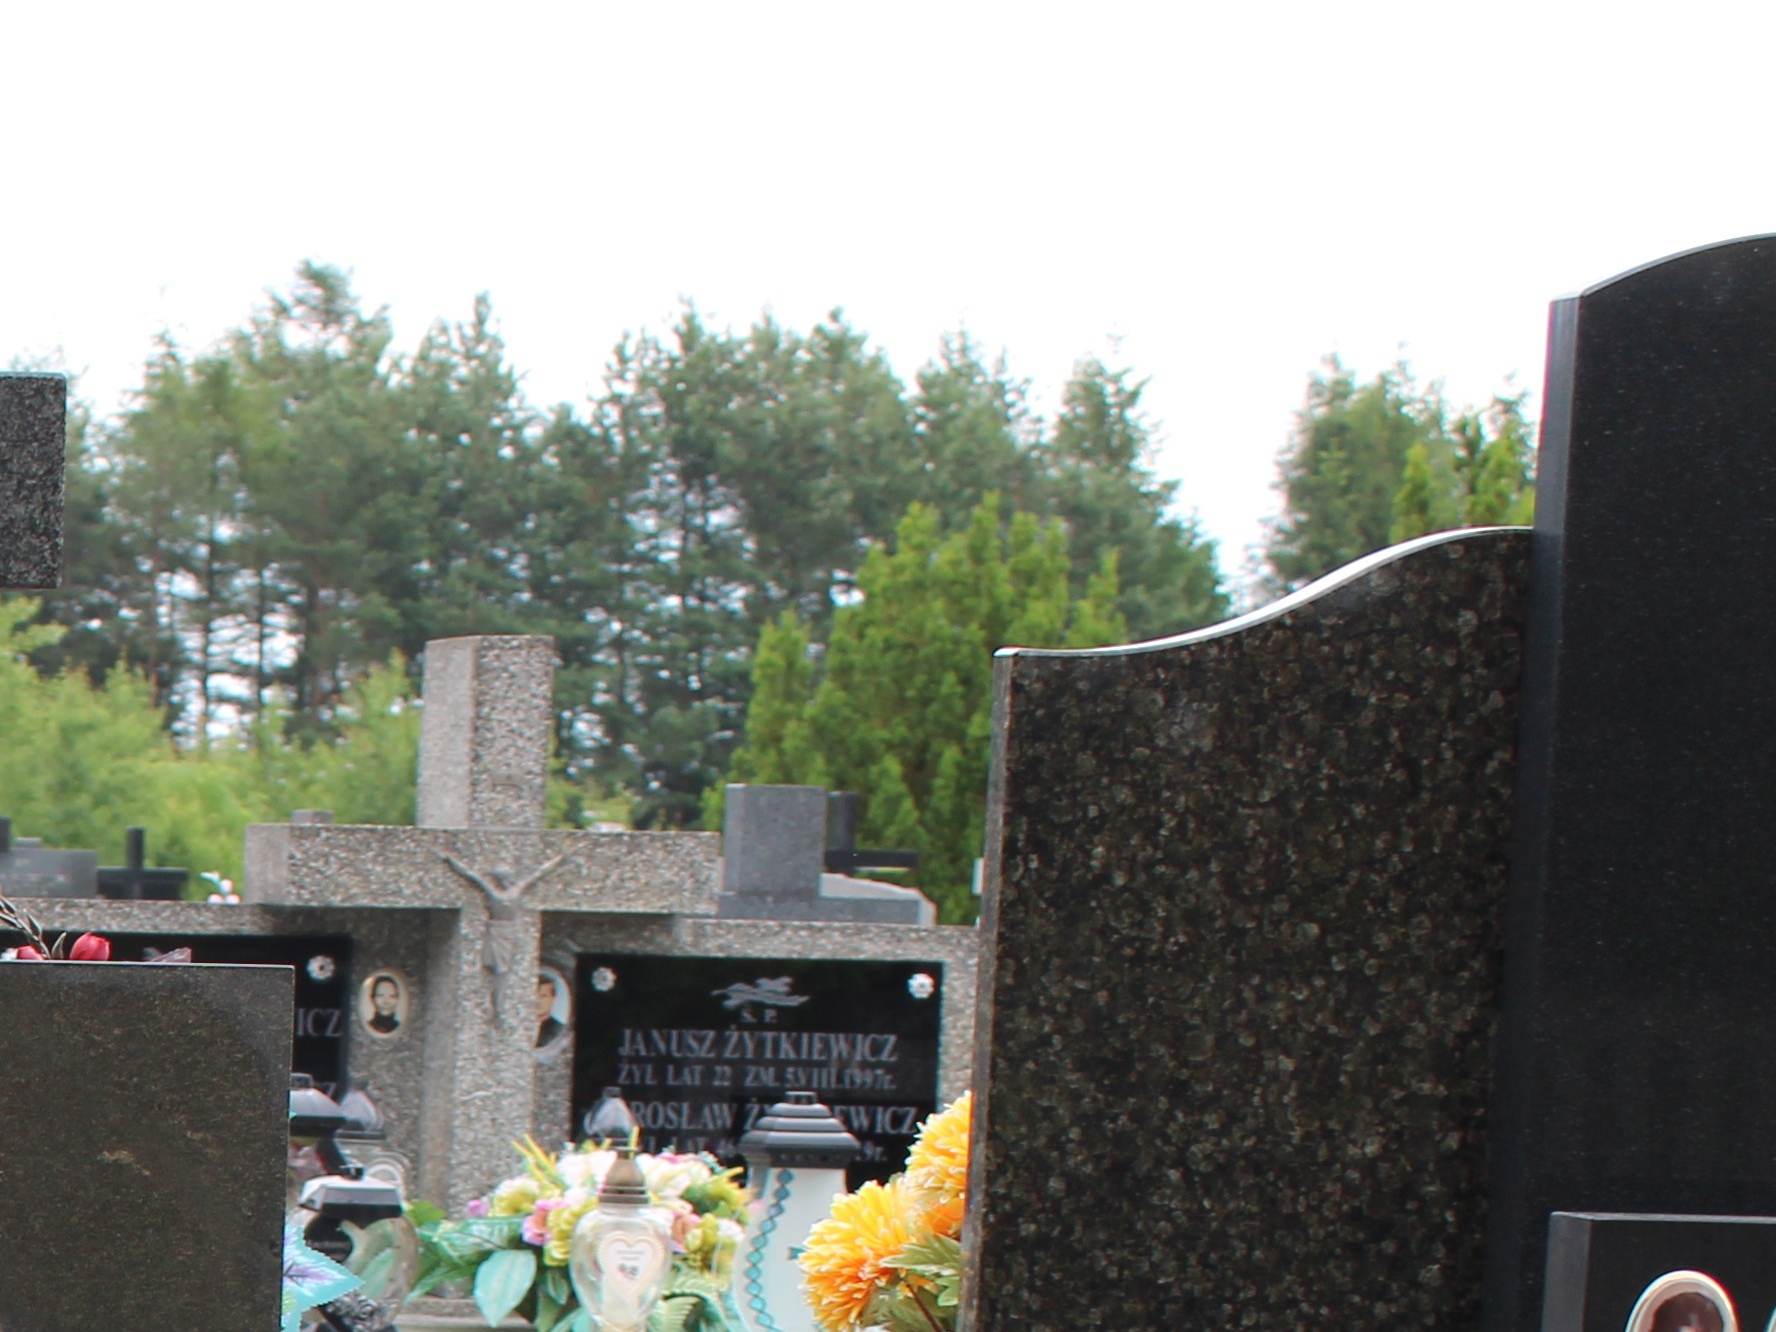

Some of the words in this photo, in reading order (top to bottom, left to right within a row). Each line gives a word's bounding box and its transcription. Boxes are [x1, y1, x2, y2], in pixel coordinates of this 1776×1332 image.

[618, 1028, 716, 1059] JANUSZ
[724, 1024, 899, 1063] ŻYTKIEWICZ
[666, 1064, 704, 1087] LAT
[633, 1100, 738, 1131] ROSŁAW
